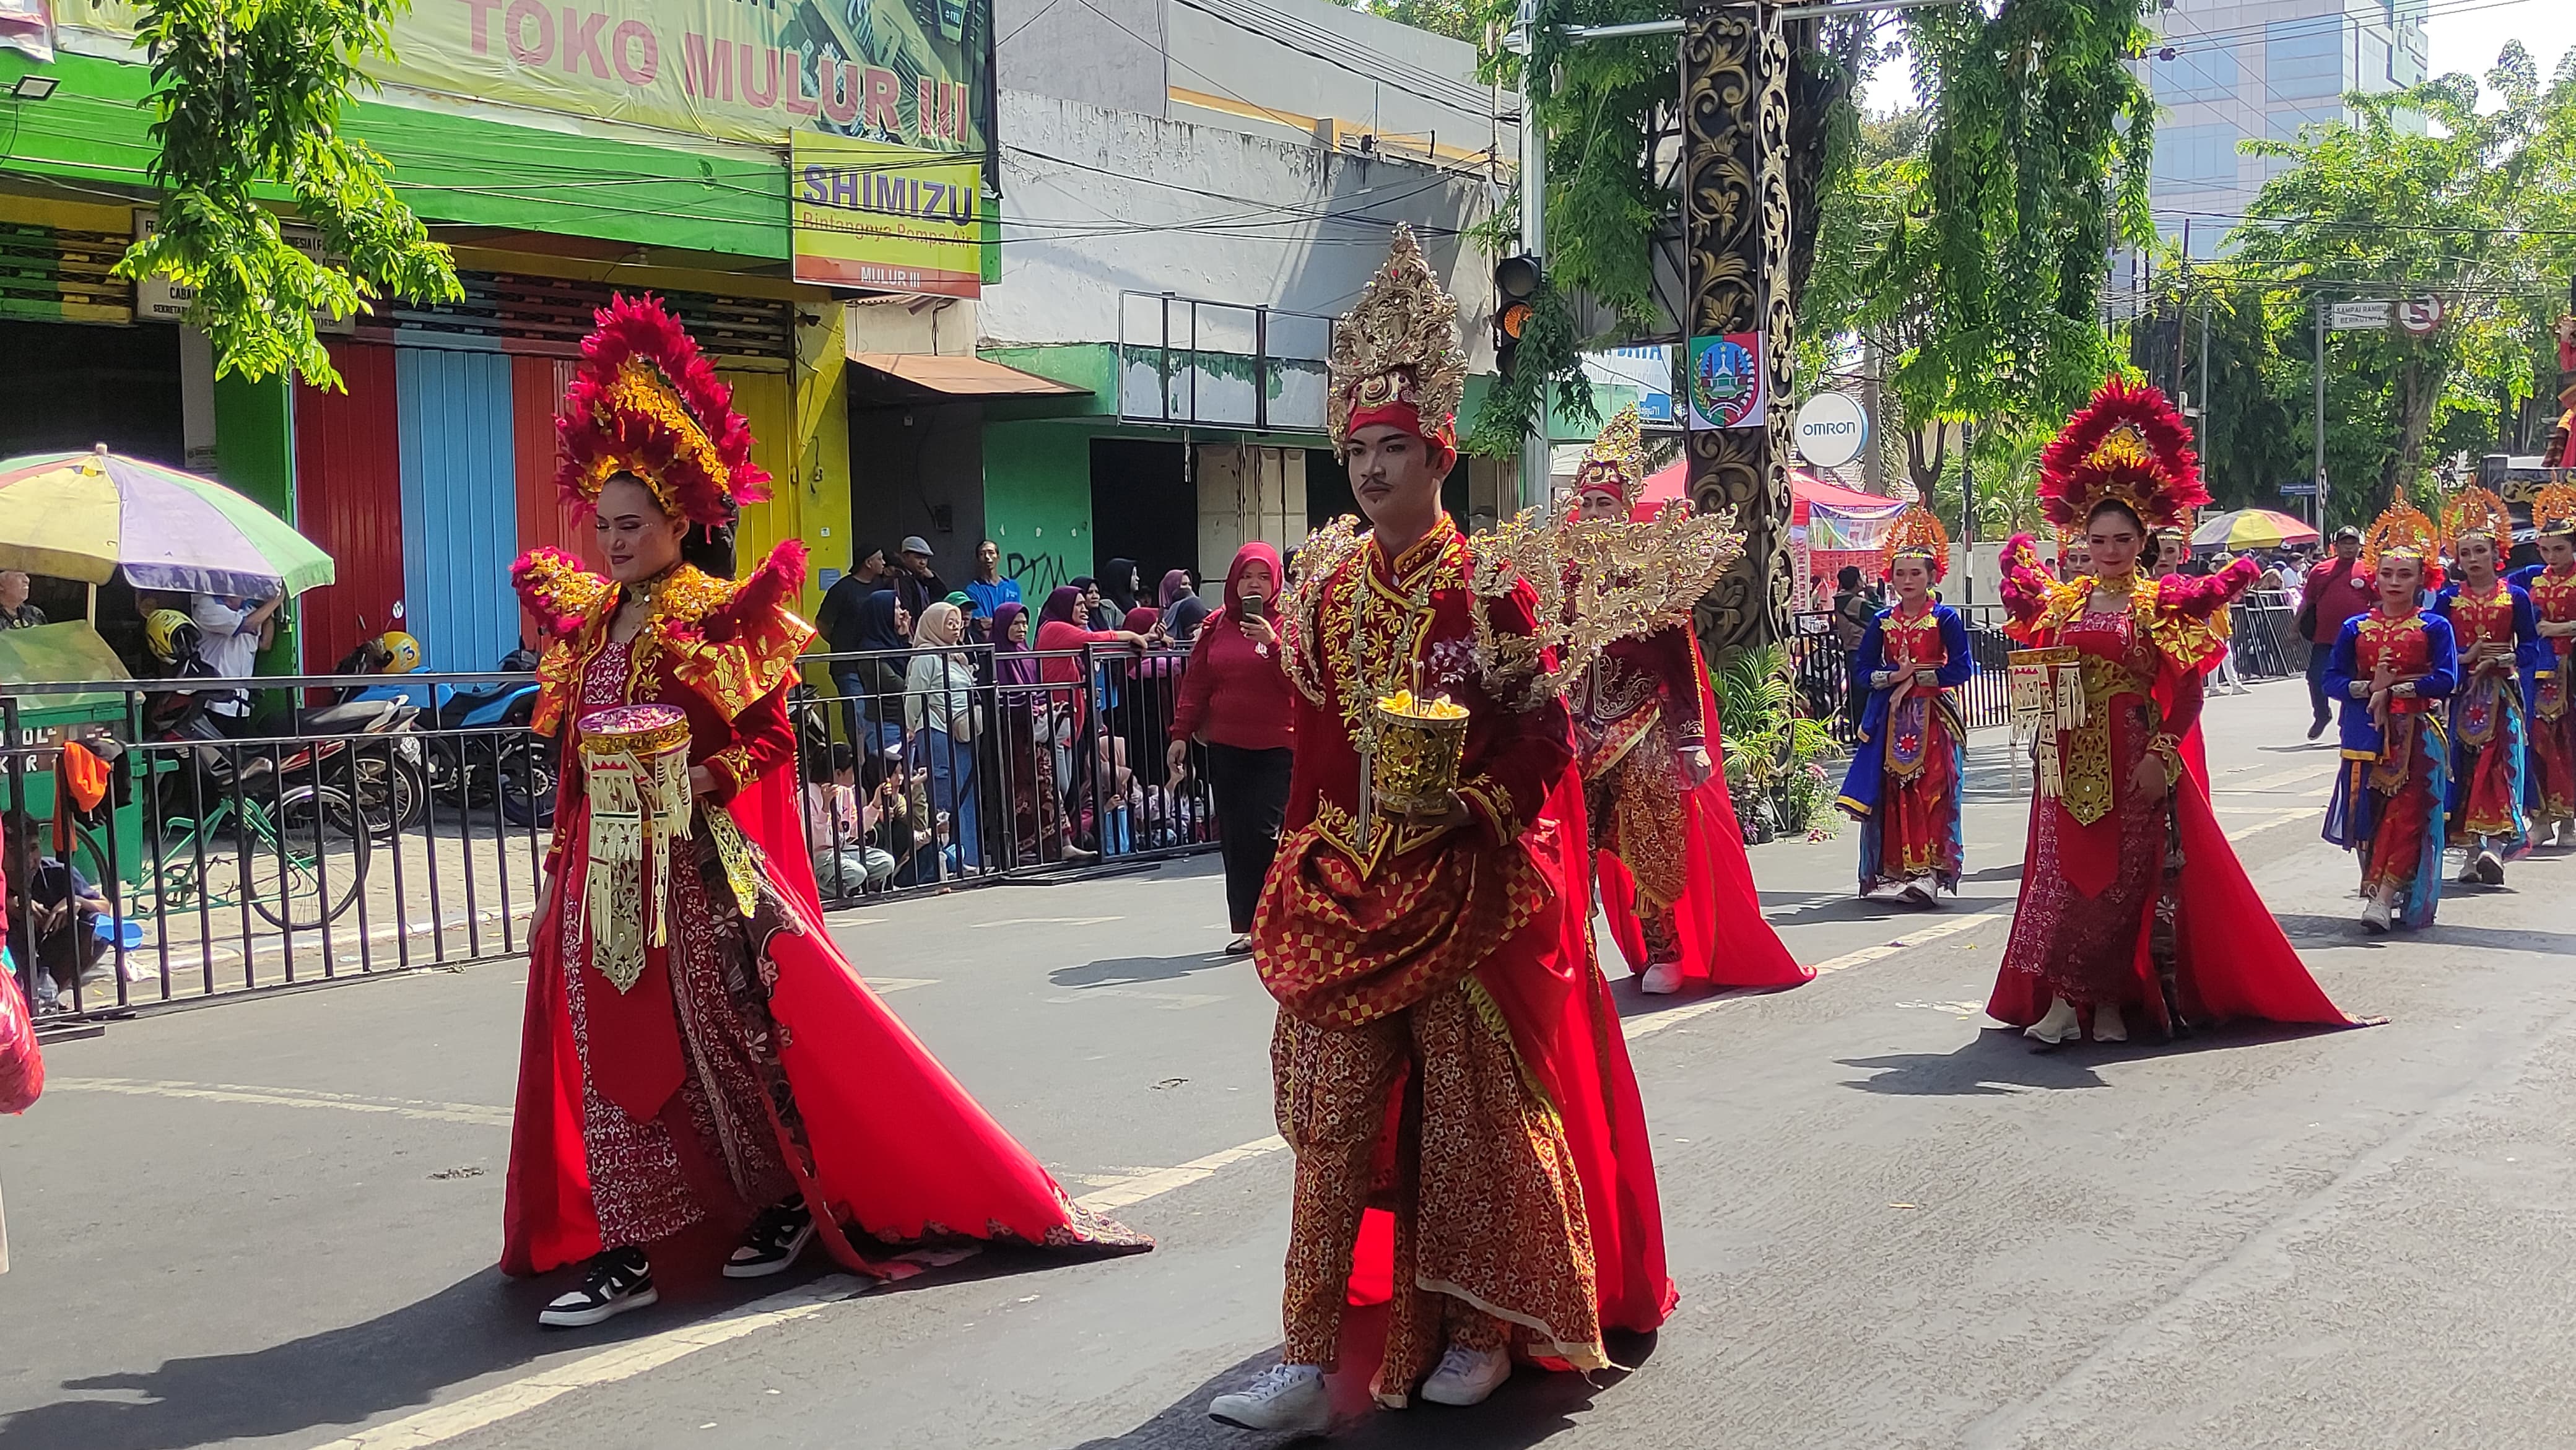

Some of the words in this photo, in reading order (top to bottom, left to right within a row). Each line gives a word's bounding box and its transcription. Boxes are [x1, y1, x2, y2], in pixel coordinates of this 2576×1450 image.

[457, 0, 658, 86] TOKO
[685, 32, 900, 131] MULUR
[918, 78, 968, 142] III
[803, 164, 973, 227] SHIMIZU
[803, 212, 892, 241] Bintangnya
[898, 224, 946, 248] Pompa
[952, 230, 973, 249] Air
[861, 266, 906, 287] MULUR
[910, 272, 921, 288] III
